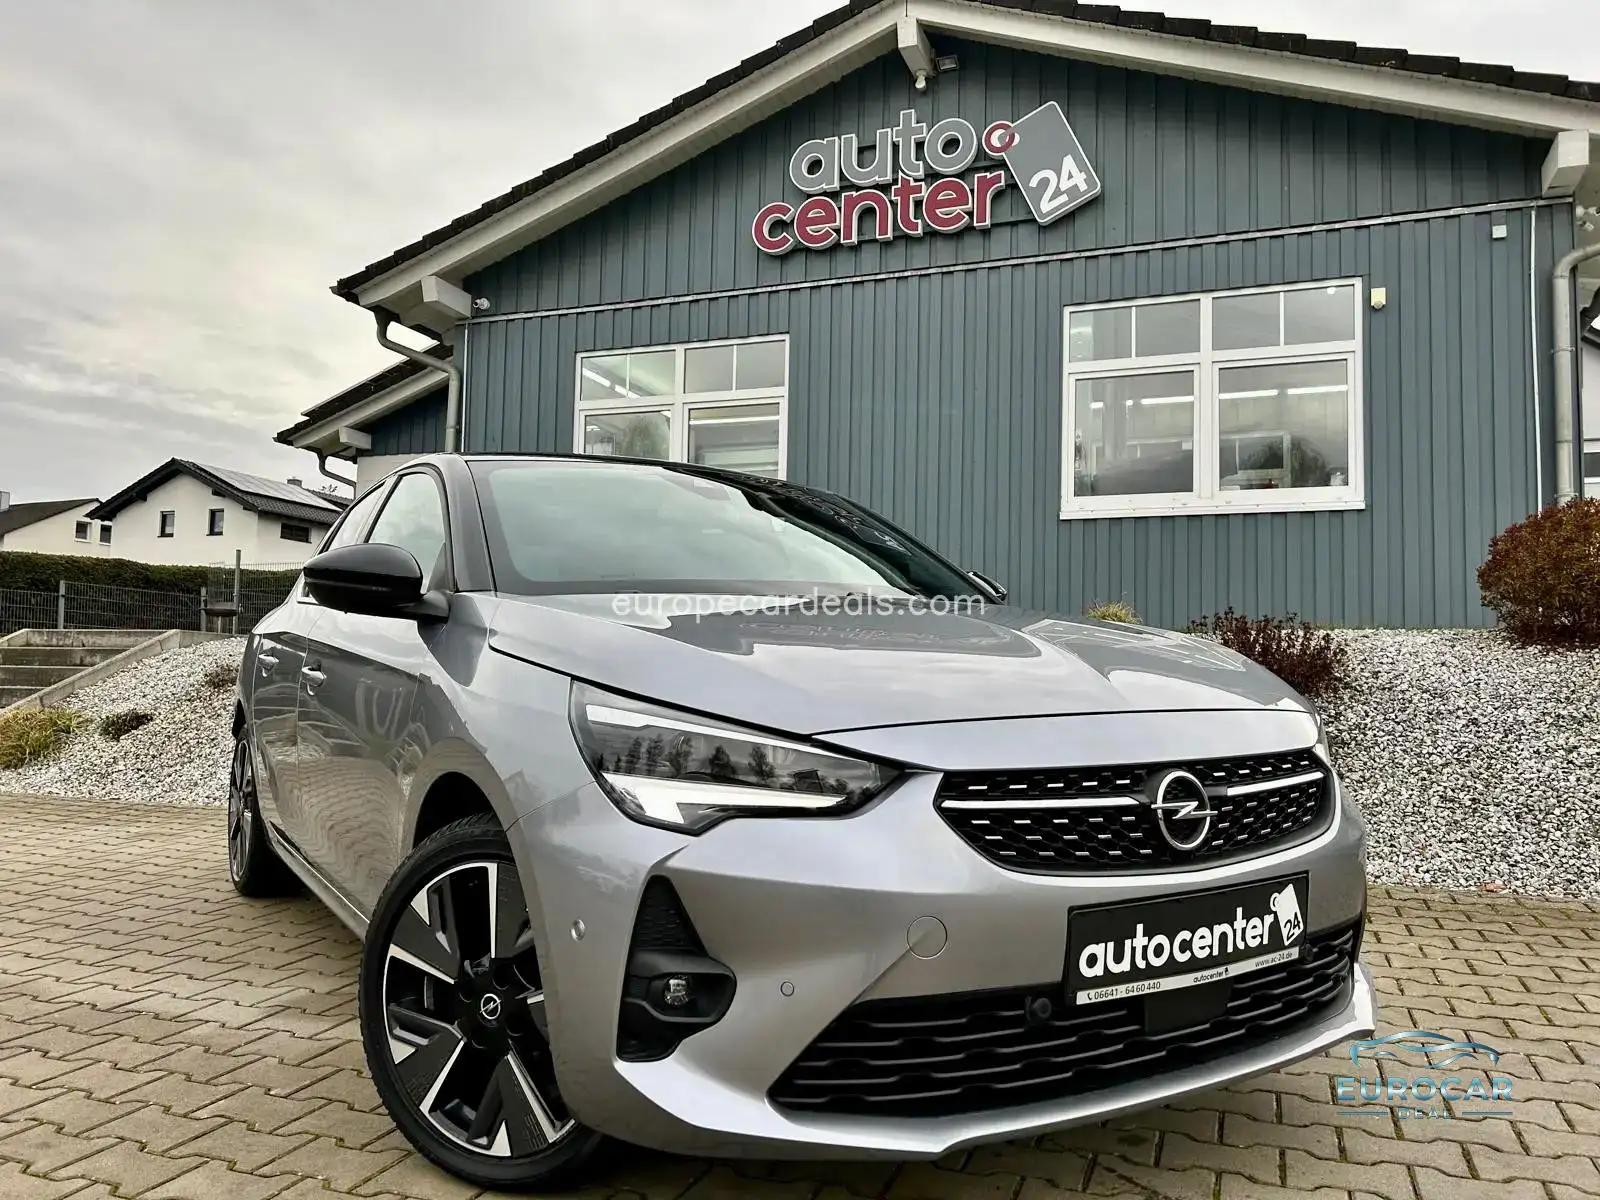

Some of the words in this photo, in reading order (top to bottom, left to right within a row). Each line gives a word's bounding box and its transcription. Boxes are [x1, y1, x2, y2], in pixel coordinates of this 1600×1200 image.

[789, 109, 978, 195] auto
[1029, 154, 1087, 213] 24
[752, 169, 1004, 255] center
[1079, 906, 1274, 978] autocenter
[1284, 912, 1301, 942] 24
[1094, 988, 1118, 1000] 06641
[1193, 971, 1224, 983] autocenter
